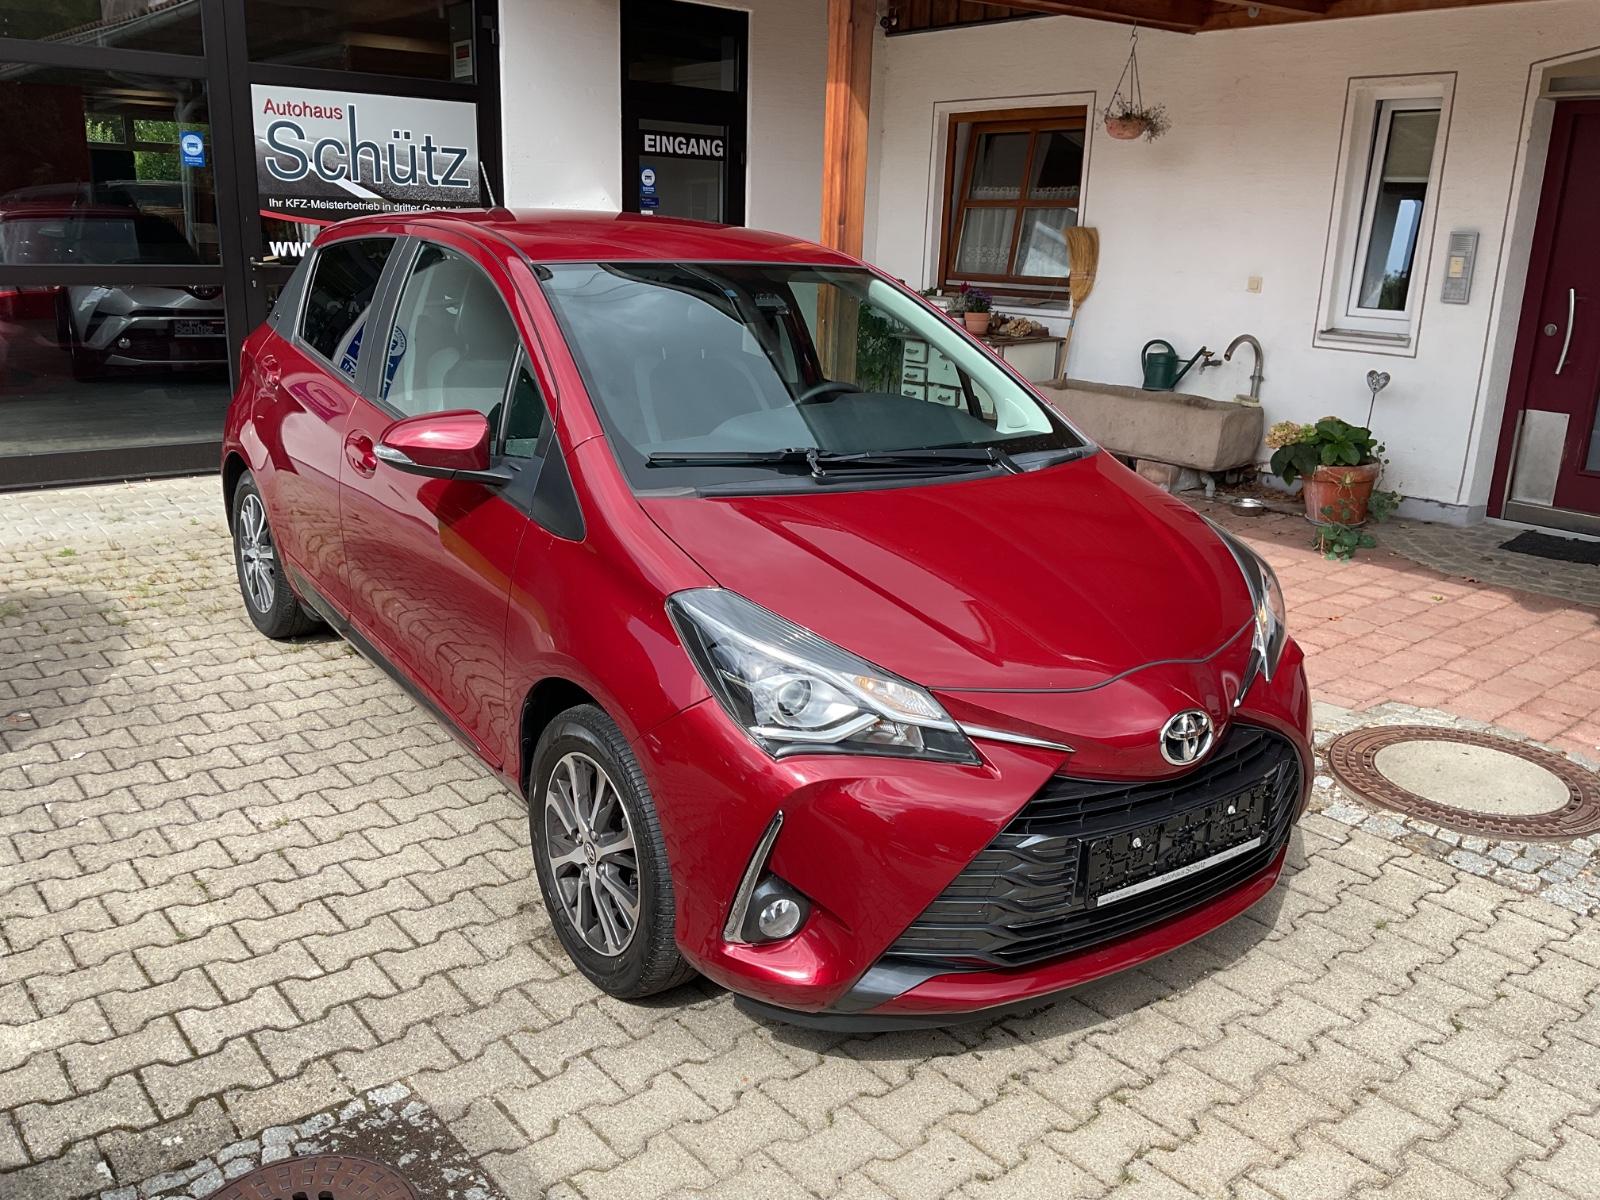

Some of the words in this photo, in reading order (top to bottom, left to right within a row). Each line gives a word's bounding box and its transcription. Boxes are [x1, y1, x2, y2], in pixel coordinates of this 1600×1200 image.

[263, 98, 343, 120] Autohaus
[265, 104, 470, 187] Schütz
[644, 134, 724, 157] EINGANG
[269, 198, 283, 208] Ihr
[286, 199, 380, 212] KFZ-Meisterbetrieb
[382, 203, 391, 211] in
